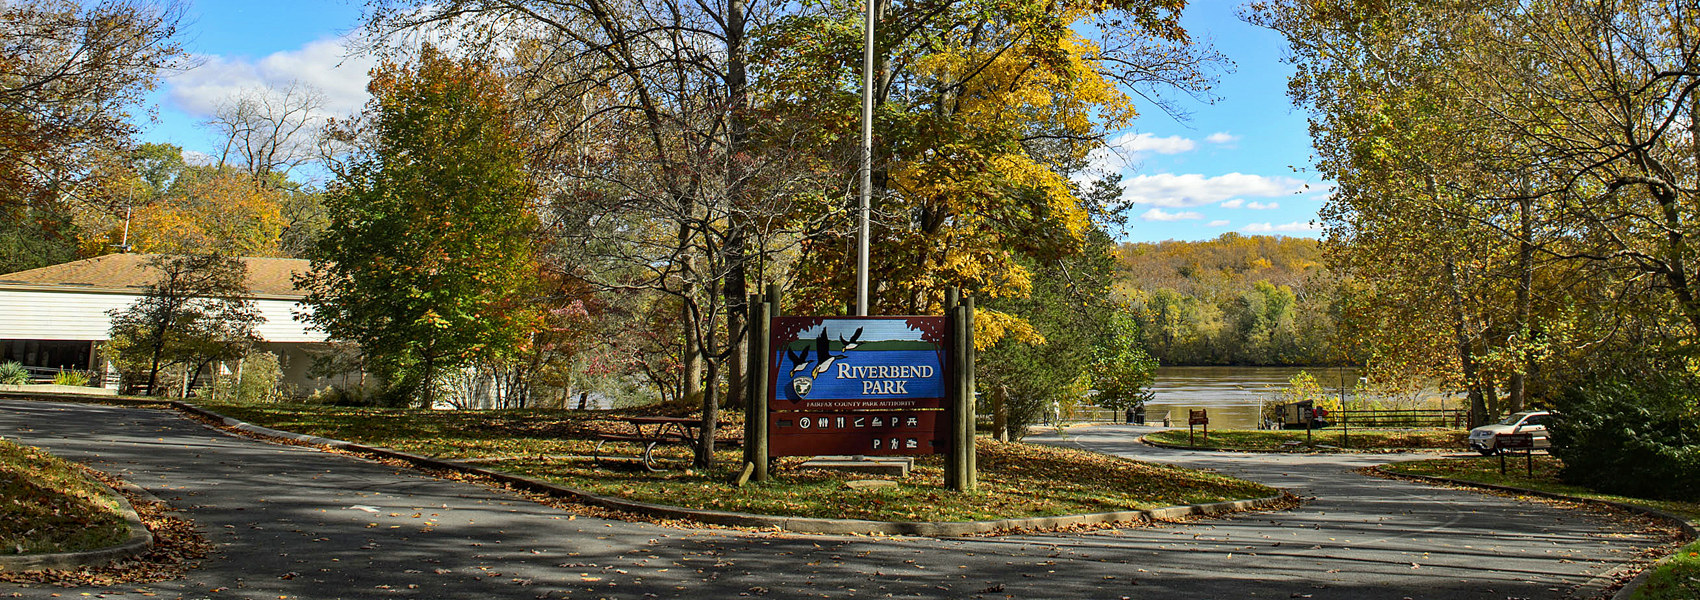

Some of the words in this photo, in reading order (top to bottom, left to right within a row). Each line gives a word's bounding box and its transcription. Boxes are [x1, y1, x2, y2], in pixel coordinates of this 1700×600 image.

[836, 362, 934, 379] RIVERBEND
[862, 380, 908, 395] PARK
[892, 417, 898, 427] P
[873, 439, 880, 449] P
